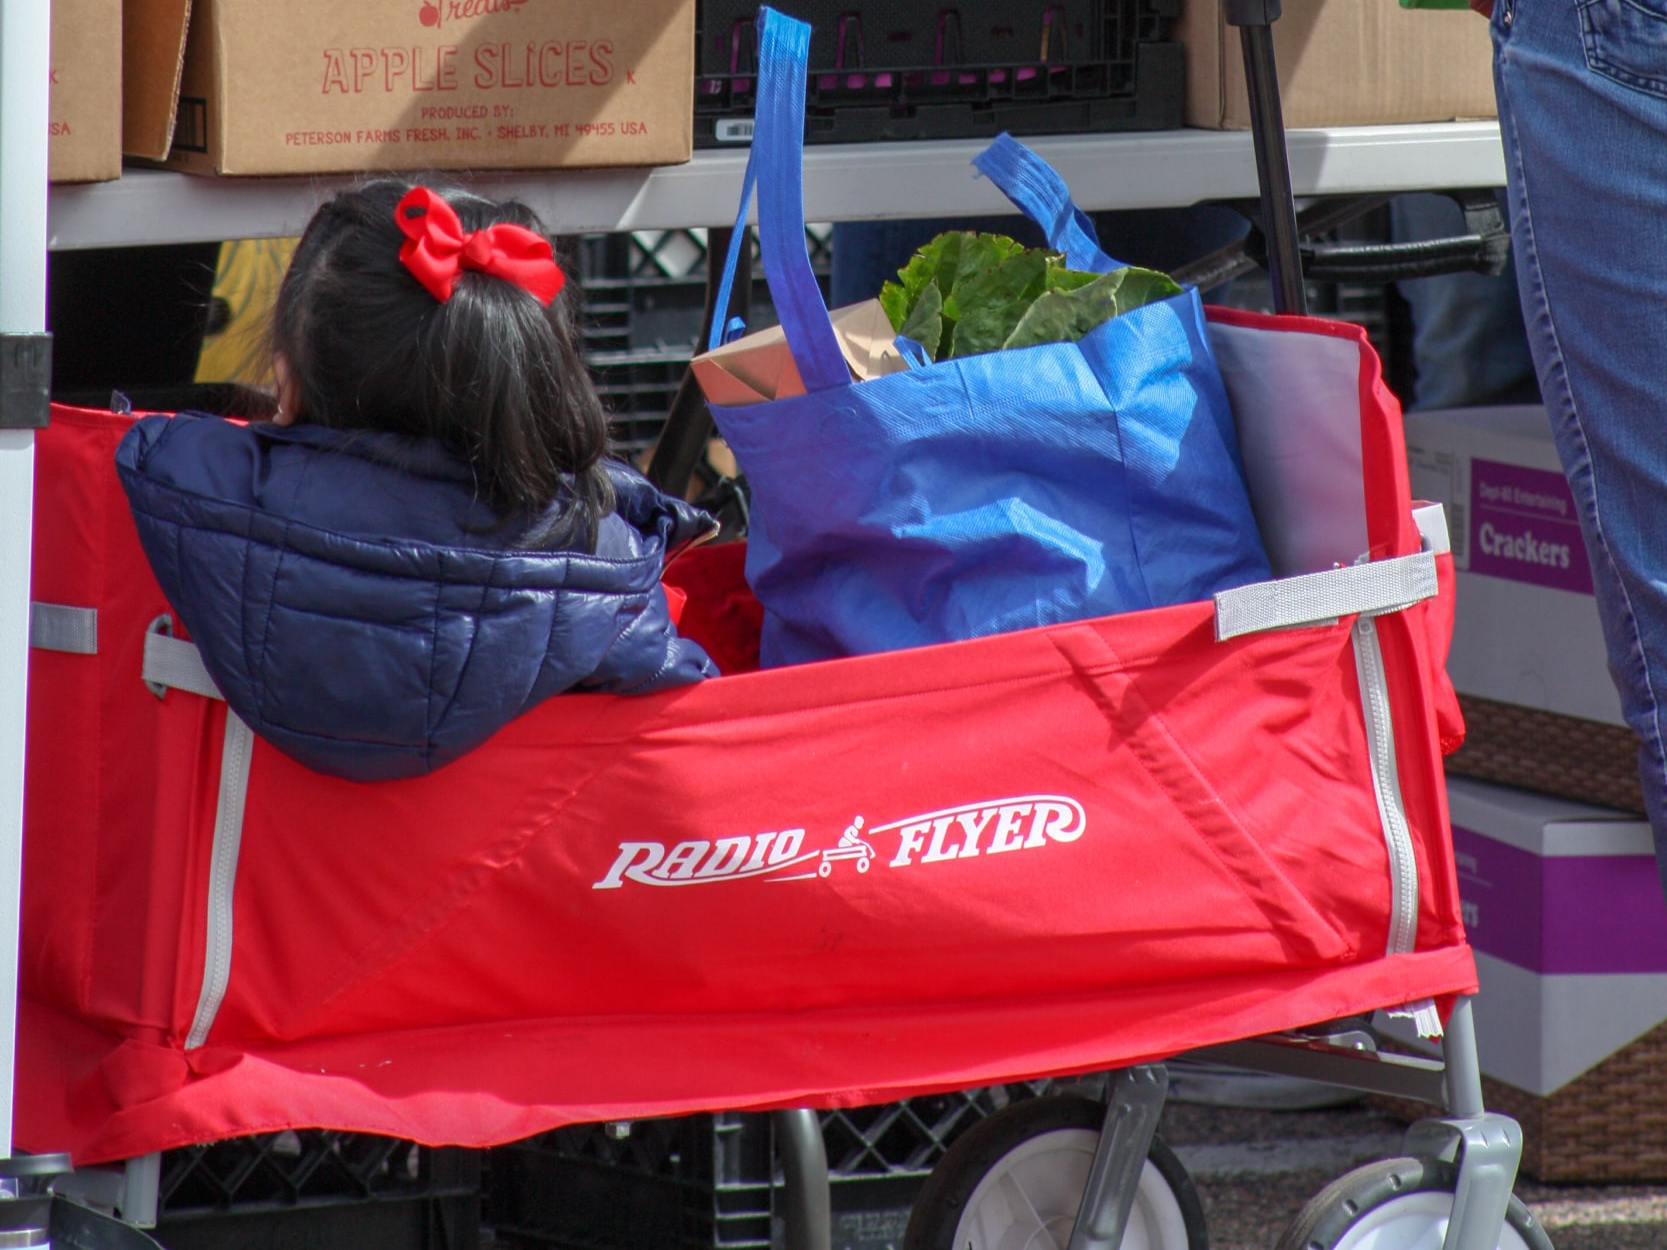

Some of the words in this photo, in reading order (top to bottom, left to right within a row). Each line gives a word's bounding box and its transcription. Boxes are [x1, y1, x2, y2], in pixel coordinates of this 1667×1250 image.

[322, 47, 458, 95] APPLE
[626, 69, 635, 84] K
[421, 105, 488, 120] PRODUCED
[493, 104, 514, 119] BY:
[49, 121, 71, 136] SA
[284, 130, 352, 146] PETERSON
[356, 128, 400, 142] FARMS
[553, 123, 569, 136] MI
[575, 121, 615, 137] 49455
[620, 121, 647, 135] USA
[1479, 522, 1570, 569] Crackers
[592, 828, 820, 890] RADIO
[888, 794, 1087, 868] FLYER
